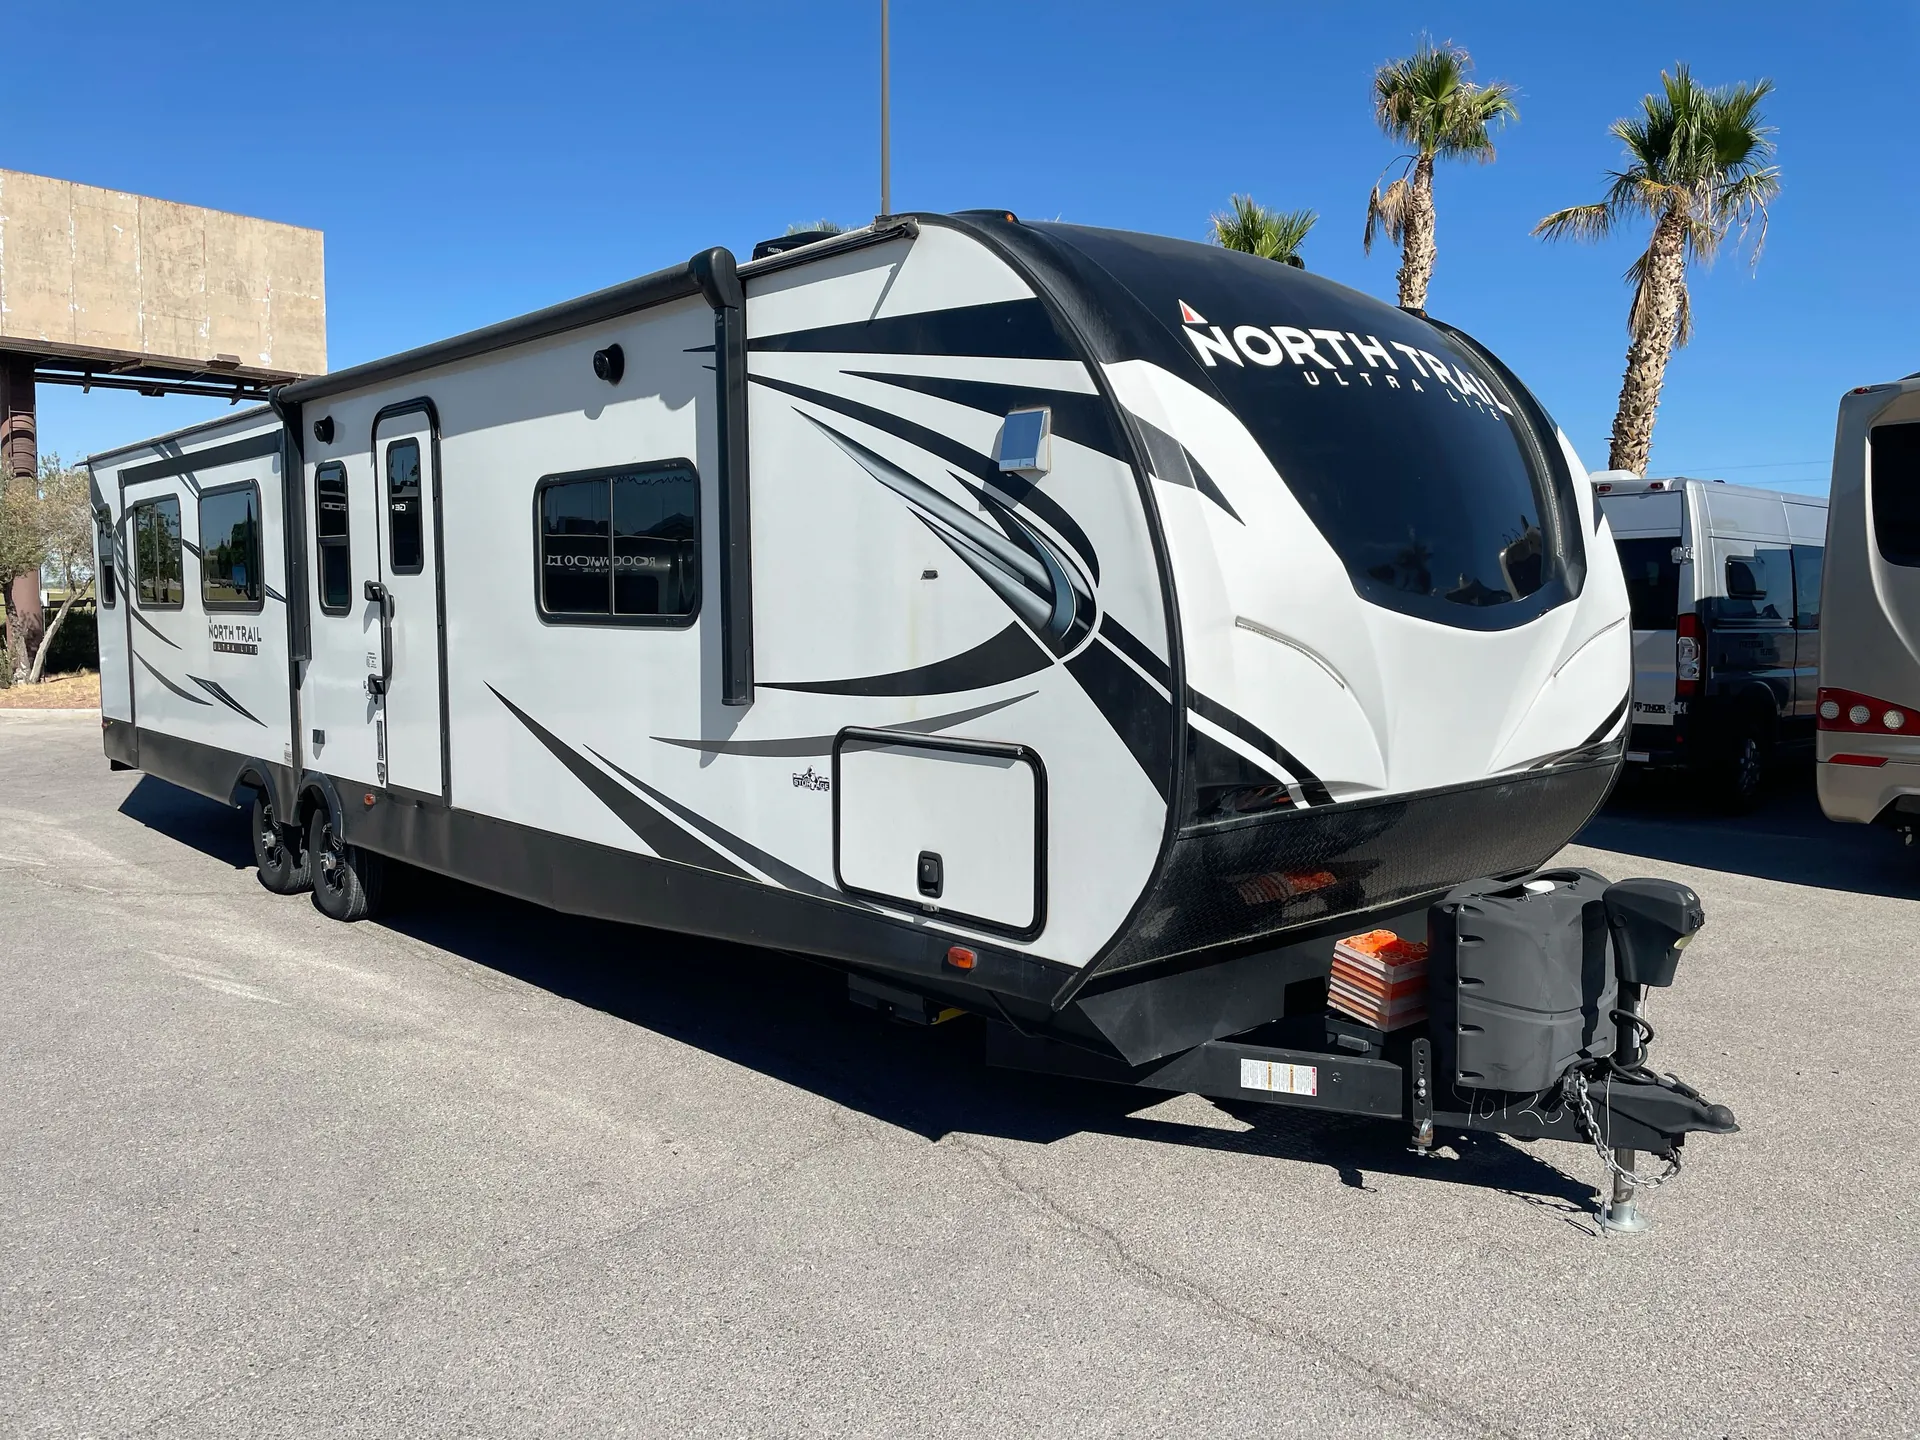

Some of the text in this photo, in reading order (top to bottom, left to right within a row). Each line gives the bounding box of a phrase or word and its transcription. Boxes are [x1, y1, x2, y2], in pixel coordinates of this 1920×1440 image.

[1181, 323, 1514, 416] NORTH TRAIL
[1303, 370, 1501, 421] ULTRA LITE
[208, 624, 262, 642] NORTH TRAIL
[213, 642, 258, 654] ULTRA LITE
[1643, 703, 1667, 713] THOR
